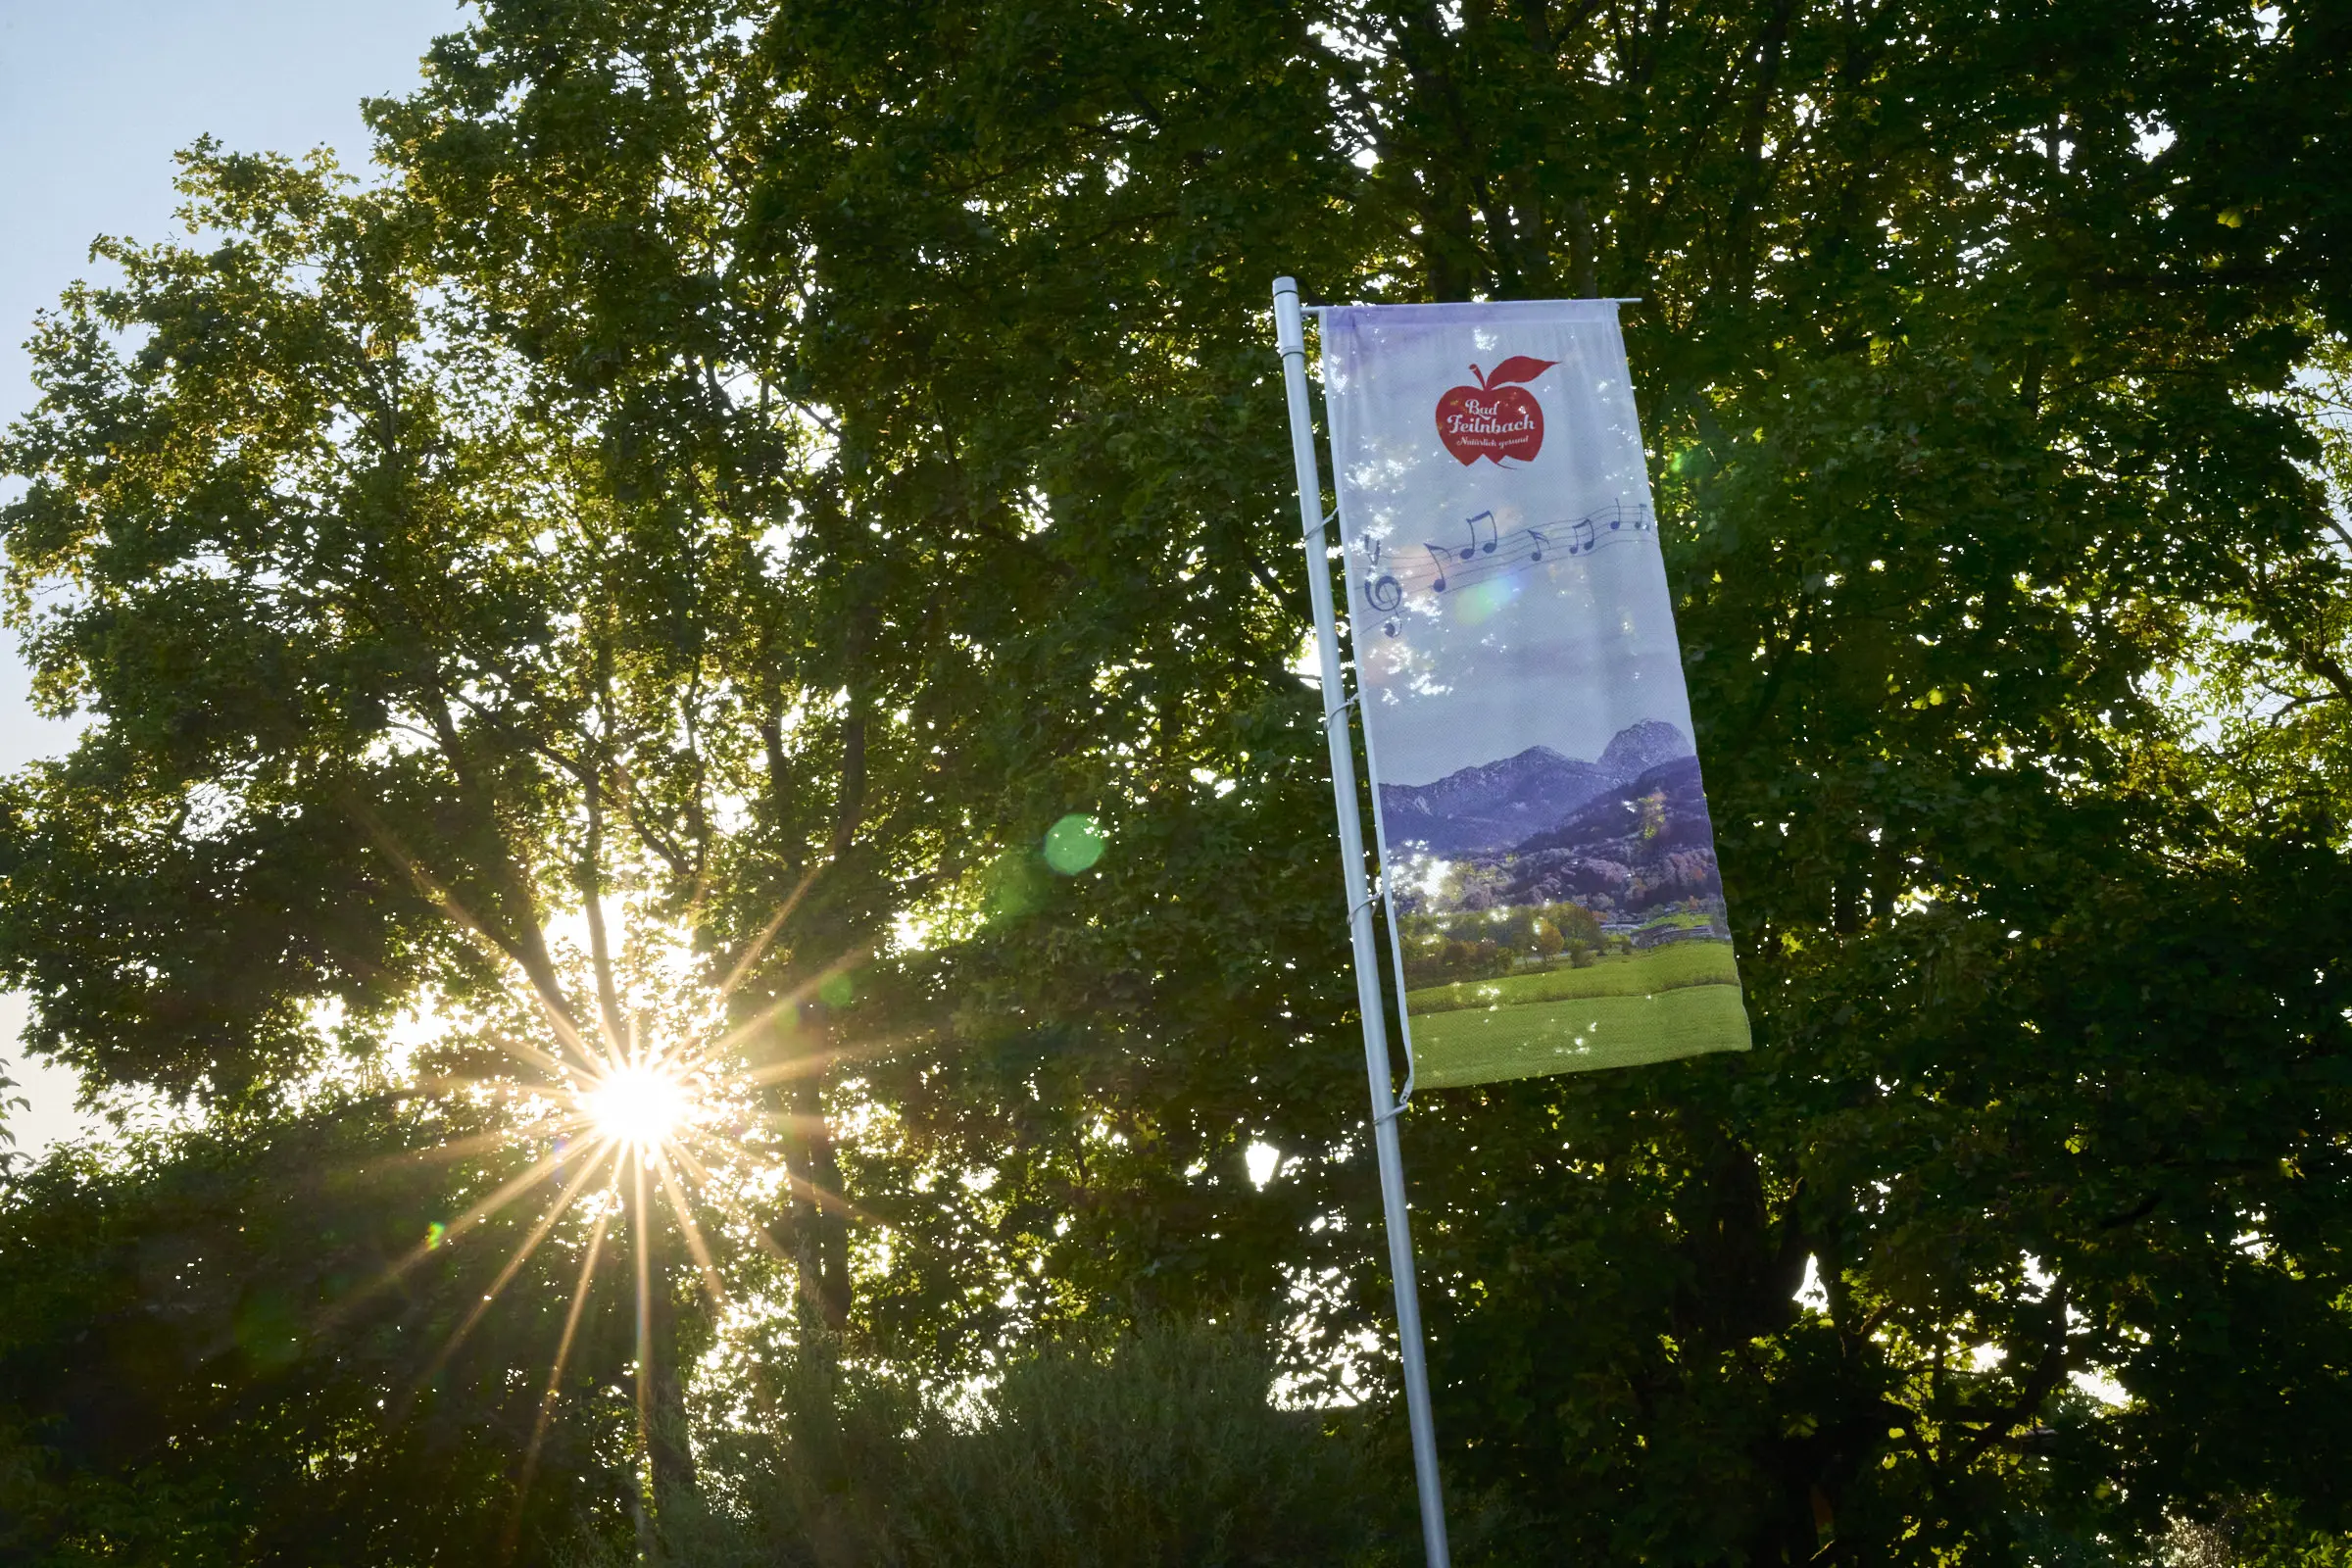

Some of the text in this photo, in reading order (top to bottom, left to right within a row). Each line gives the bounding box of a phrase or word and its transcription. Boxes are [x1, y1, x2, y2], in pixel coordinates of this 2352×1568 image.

[1465, 399, 1499, 420] Bad
[1446, 414, 1536, 434] Feilnbach
[1456, 435, 1529, 449] Natürlich gesund
